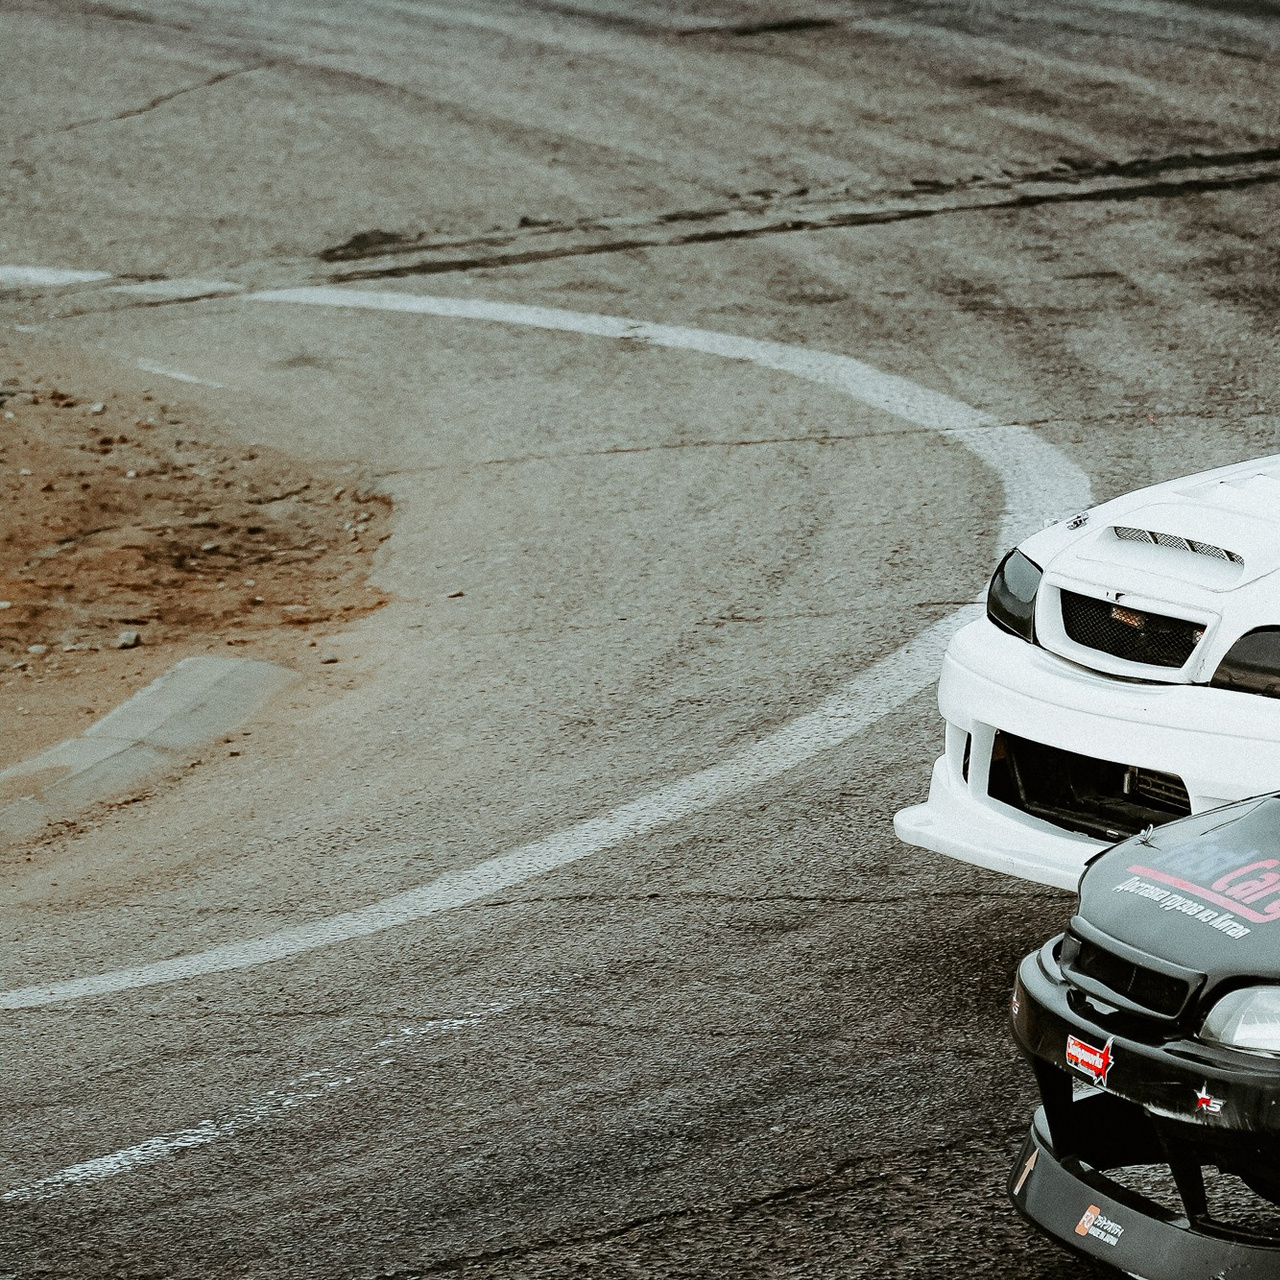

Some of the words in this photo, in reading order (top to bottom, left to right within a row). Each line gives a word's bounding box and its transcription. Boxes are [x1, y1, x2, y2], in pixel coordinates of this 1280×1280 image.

[1112, 876, 1171, 902] Доставка
[1160, 894, 1205, 916] грузов
[1195, 908, 1219, 923] из
[1208, 912, 1252, 939] Китая
